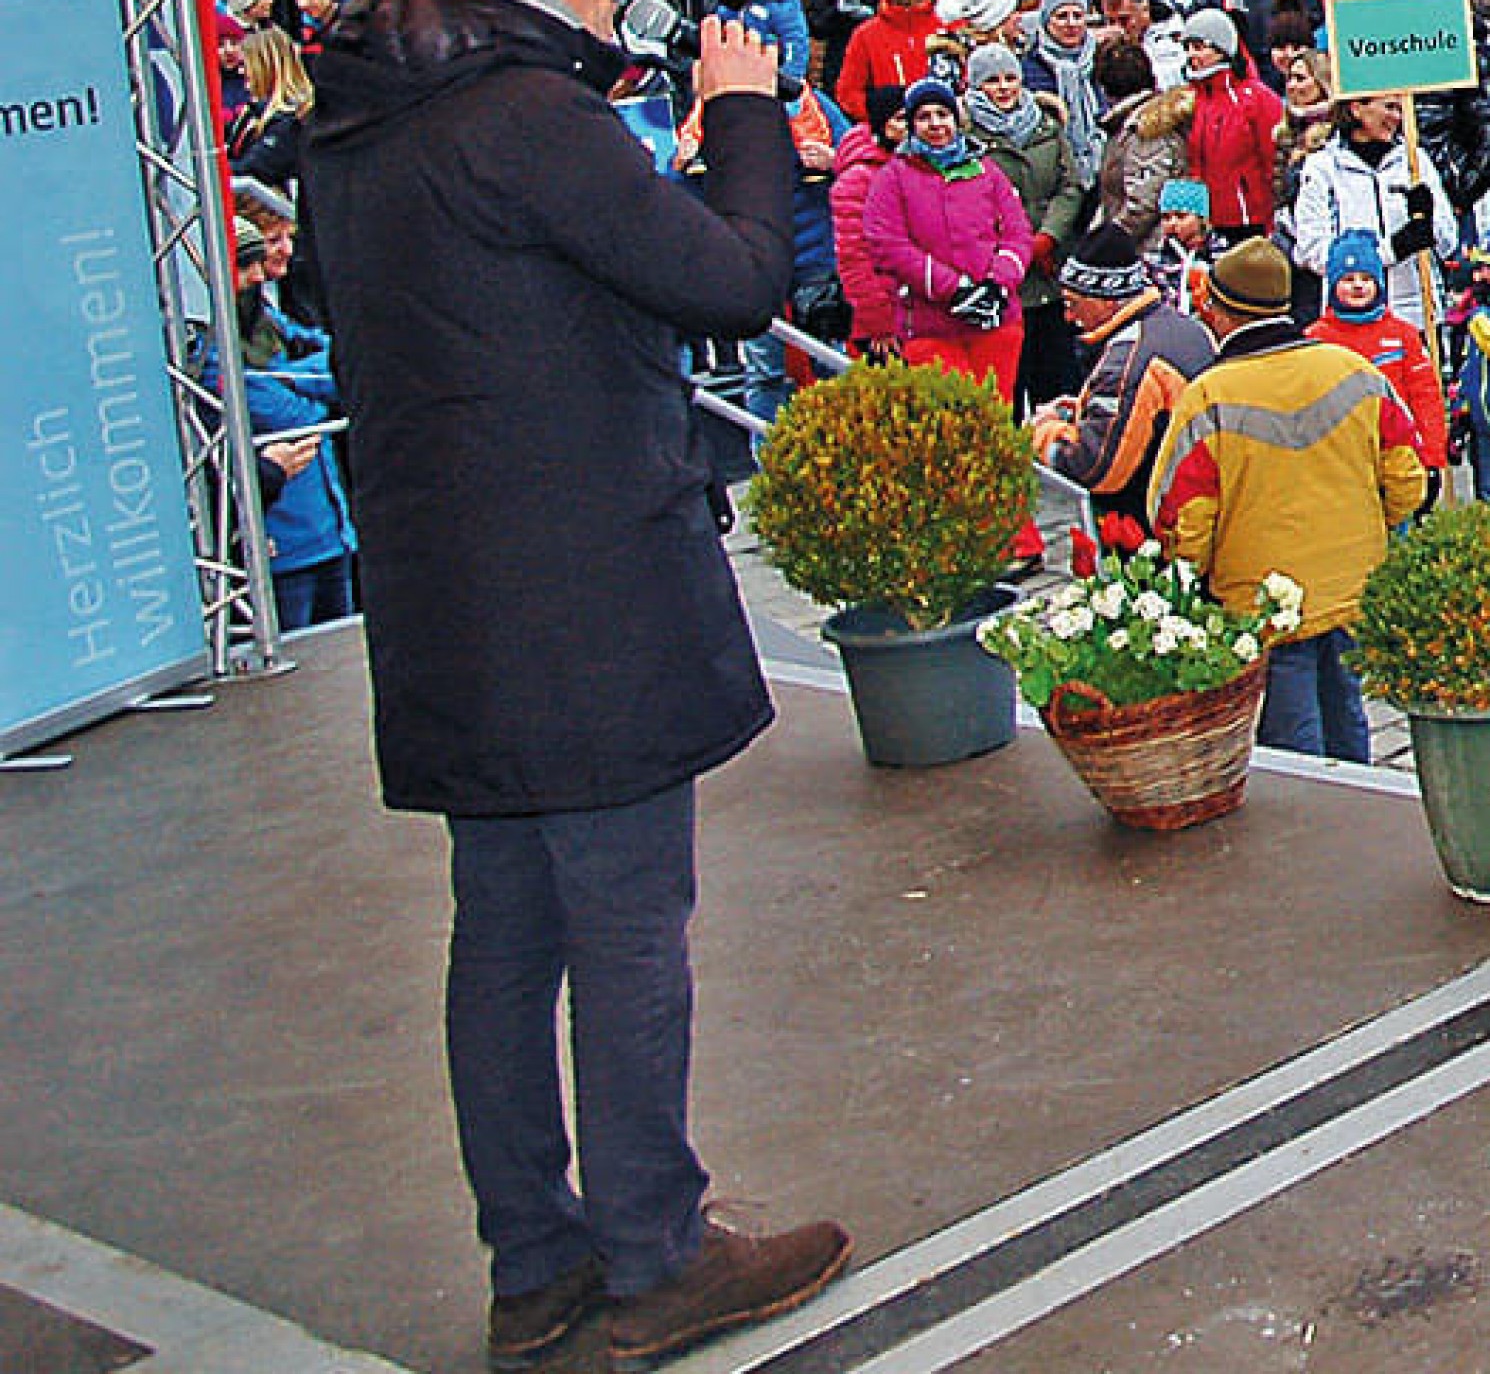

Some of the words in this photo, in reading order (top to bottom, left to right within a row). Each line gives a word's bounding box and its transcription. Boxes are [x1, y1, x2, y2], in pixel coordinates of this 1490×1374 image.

[1348, 27, 1458, 58] Vorschule
[26, 406, 116, 668] Herzlich
[59, 226, 175, 648] willkommen!
